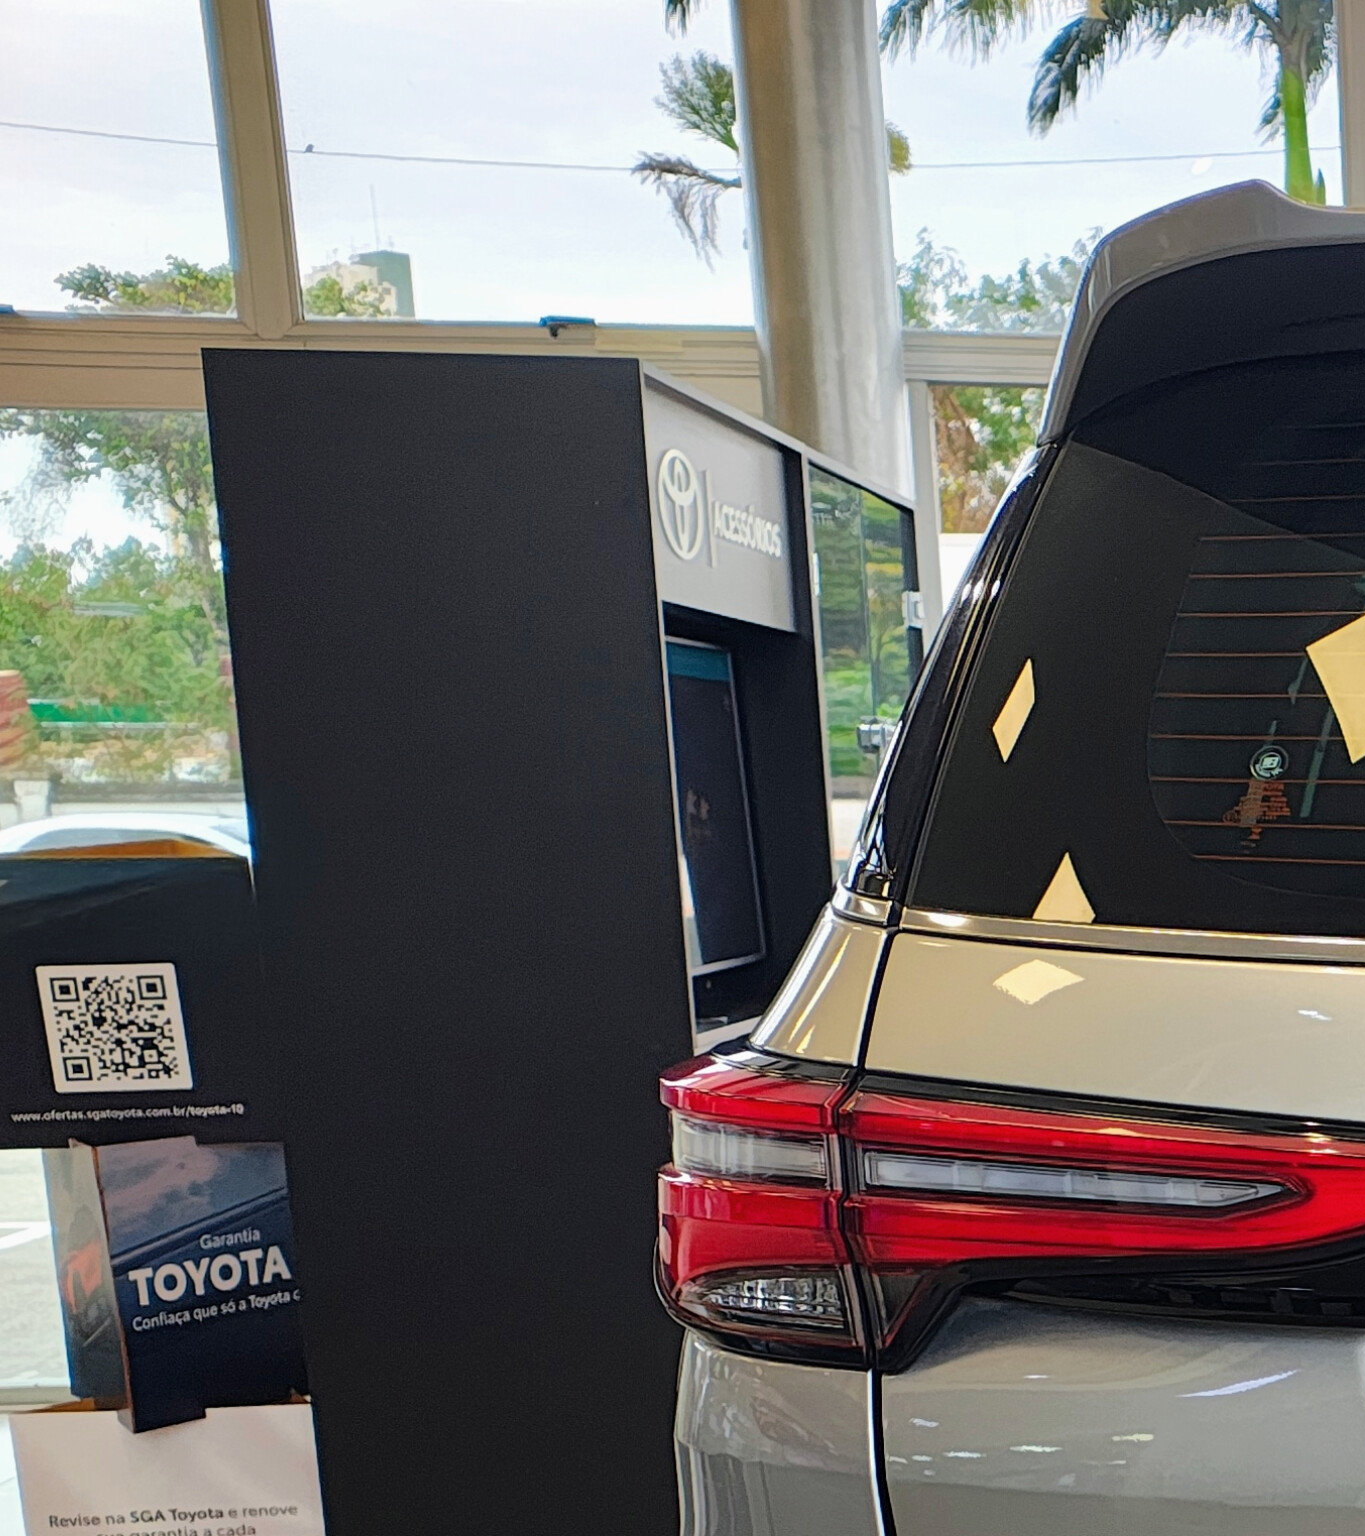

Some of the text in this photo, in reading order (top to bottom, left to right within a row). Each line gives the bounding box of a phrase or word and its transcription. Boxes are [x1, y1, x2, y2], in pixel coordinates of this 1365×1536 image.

[200, 1227, 260, 1249] Garantia
[128, 1245, 292, 1306] TOYOTA
[193, 1305, 218, 1322] que
[221, 1300, 236, 1315] só
[238, 1300, 247, 1311] a
[249, 1291, 290, 1309] Toyota
[49, 1505, 299, 1528] Revise na SGA Toyota e renove
